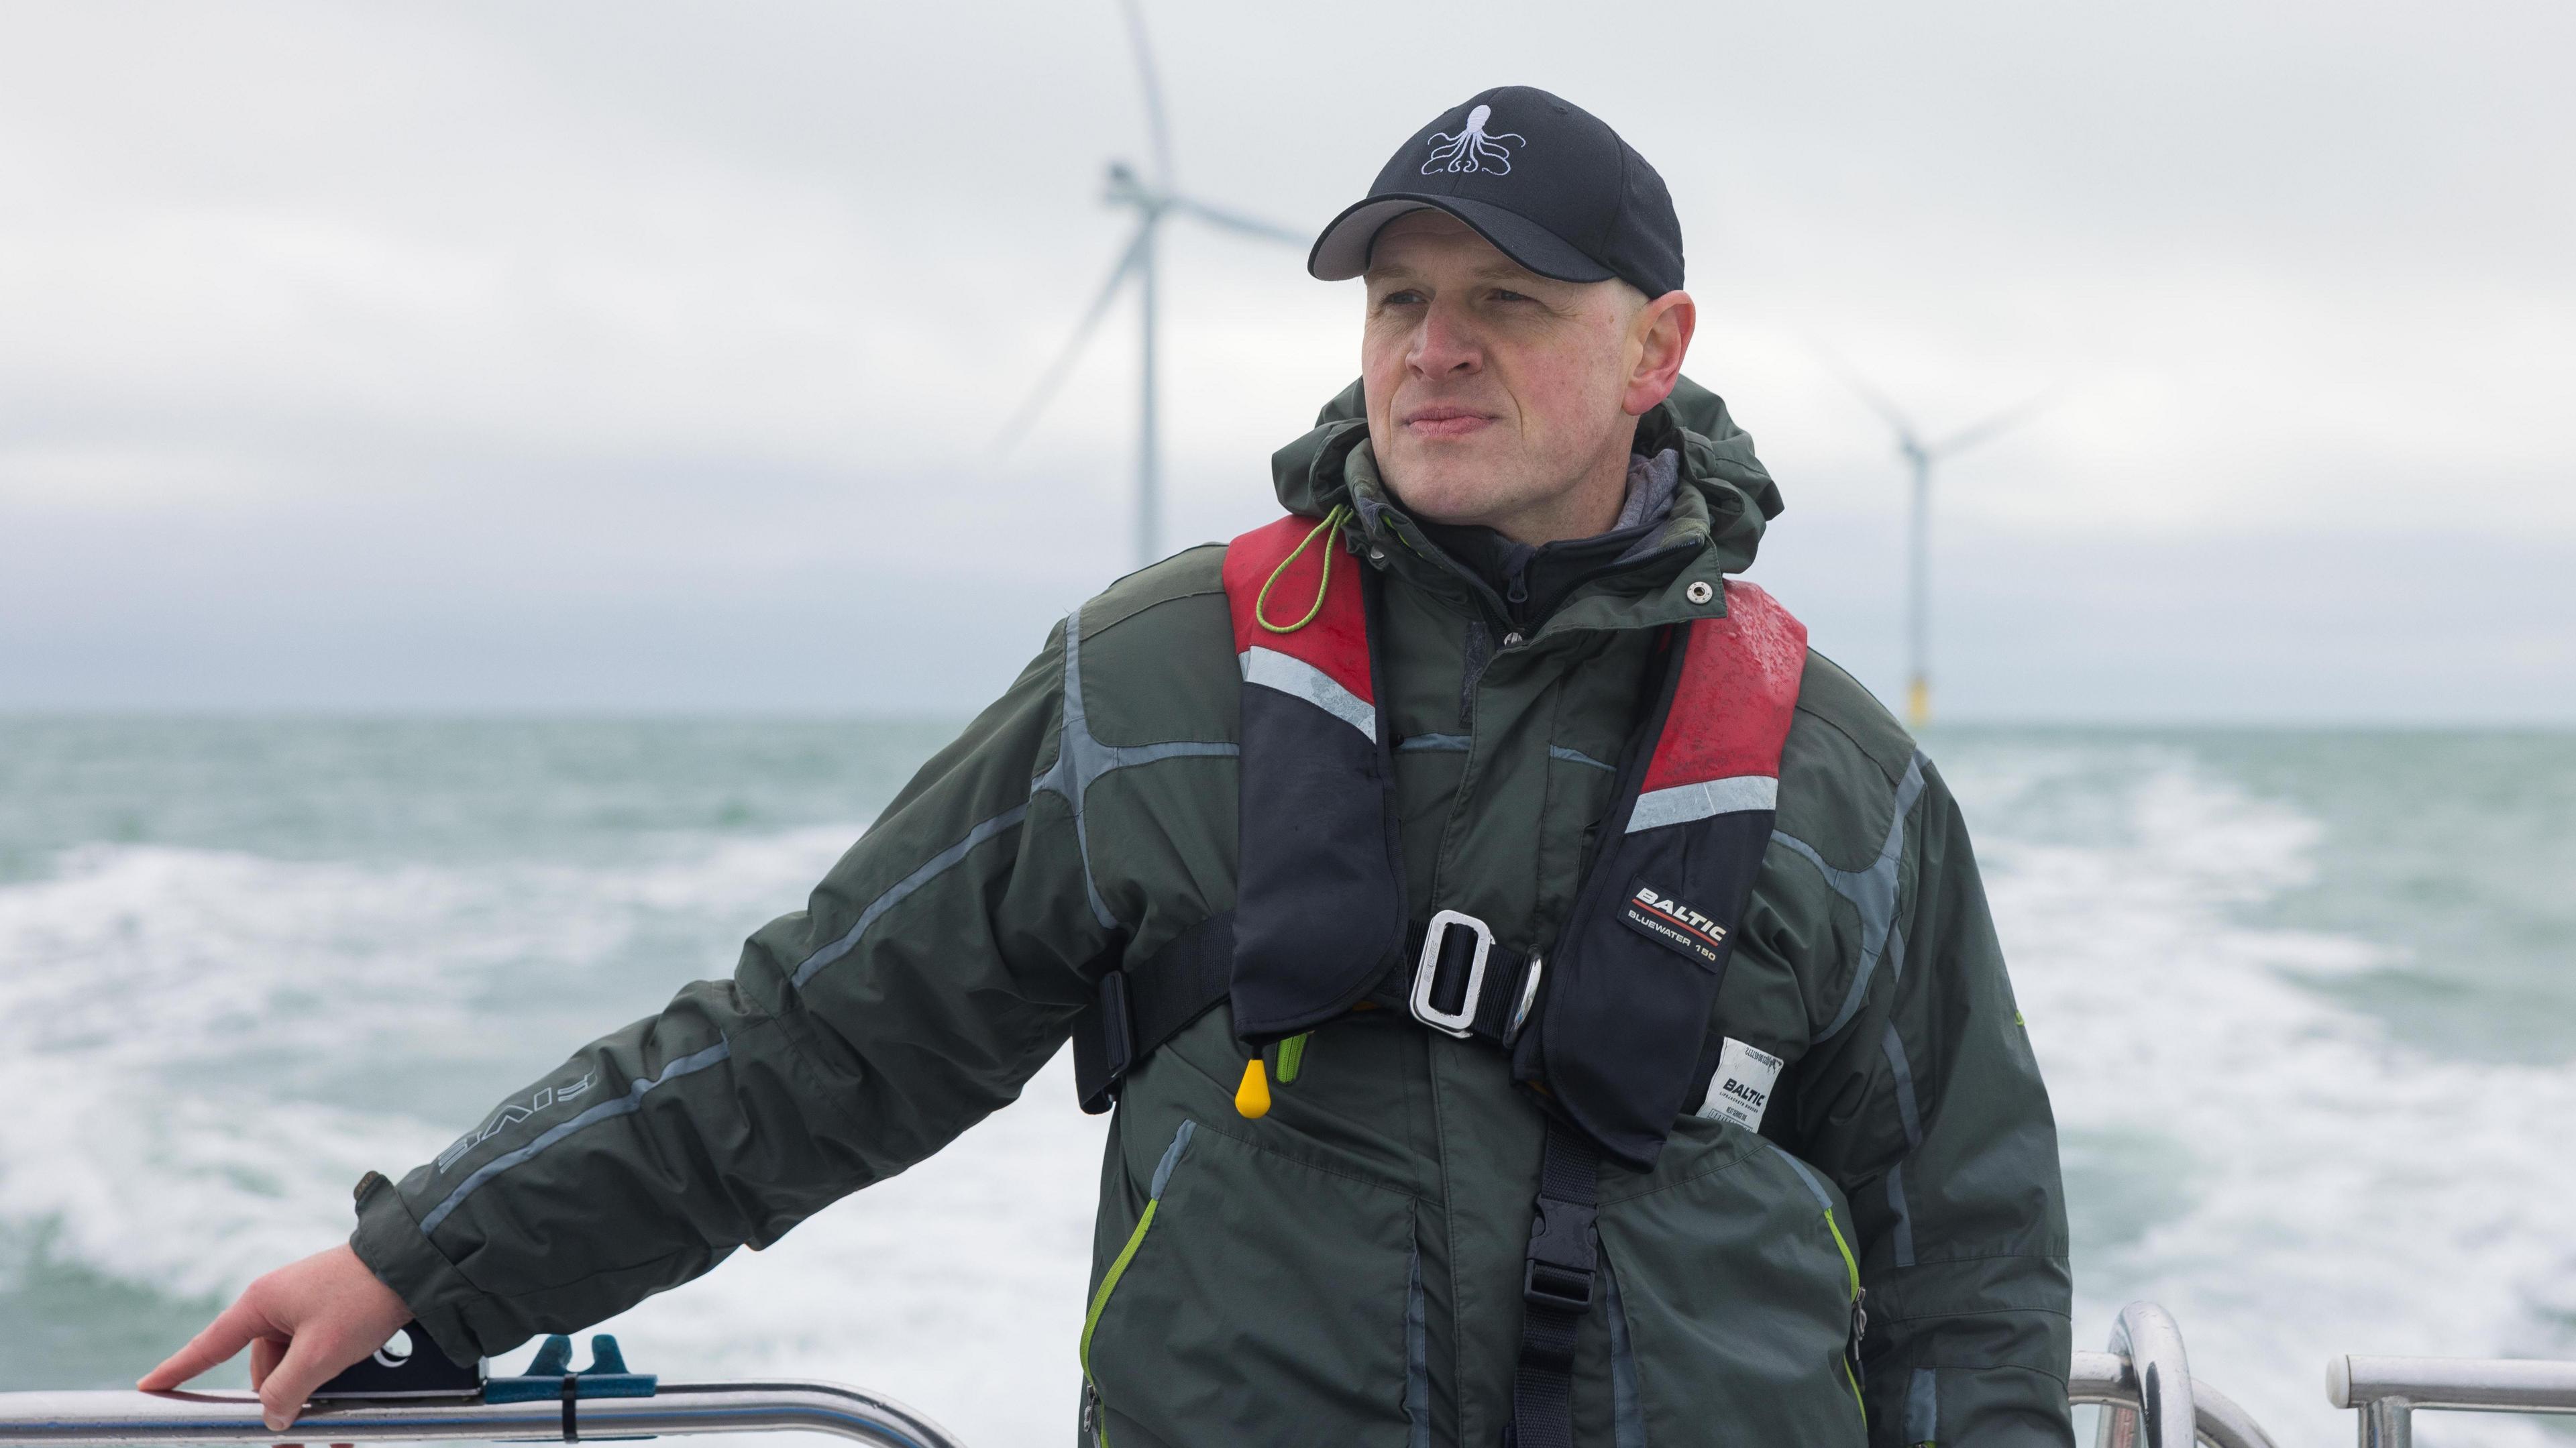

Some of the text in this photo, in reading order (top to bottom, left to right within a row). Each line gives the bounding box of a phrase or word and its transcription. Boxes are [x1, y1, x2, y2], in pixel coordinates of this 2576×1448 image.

[1627, 909, 1716, 961] BLUEWATER 150
[1635, 887, 1727, 942] BALTIC
[1723, 1078, 1766, 1107] BALTIC
[438, 1065, 598, 1174] FIVE
